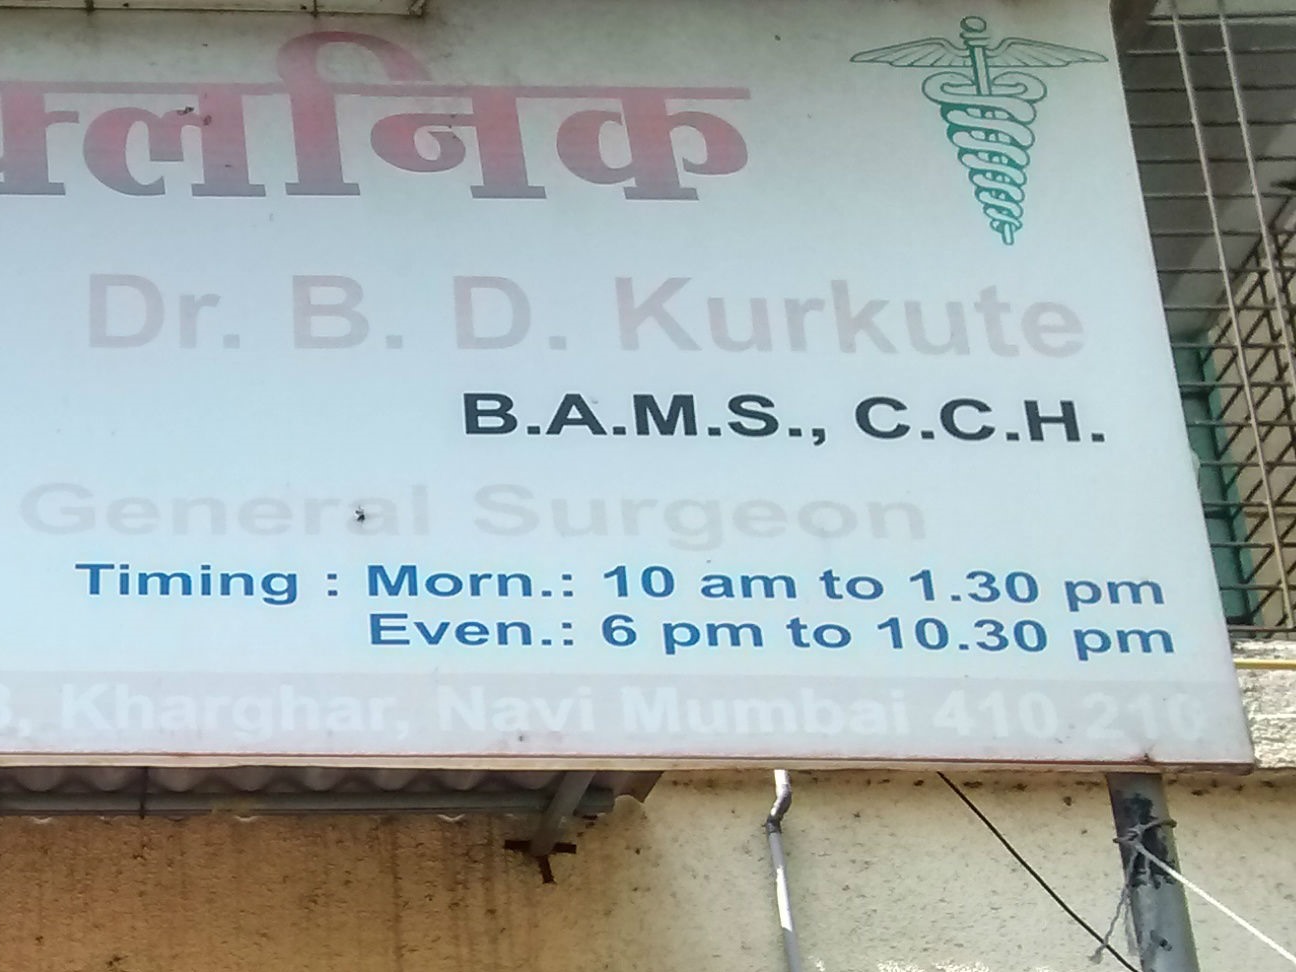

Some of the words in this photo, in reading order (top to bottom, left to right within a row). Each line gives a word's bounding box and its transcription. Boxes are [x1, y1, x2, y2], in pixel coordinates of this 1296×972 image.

[88, 272, 240, 350] Dr.
[291, 272, 404, 350] B.
[452, 275, 568, 351] D.
[613, 276, 1087, 359] Kurkute
[462, 392, 826, 446] B.A.M.S.,
[855, 396, 1106, 443] C.C.H.
[18, 480, 431, 537] General
[473, 483, 929, 552] Surgeon
[75, 563, 298, 605] Timing
[367, 564, 574, 598] Morn.:
[603, 565, 675, 598] 10
[700, 570, 797, 600] am
[819, 569, 884, 601] to
[909, 569, 1039, 603] 1.30
[1065, 578, 1165, 612] pm
[369, 612, 574, 646] Even.:
[601, 614, 638, 648] 6
[662, 621, 764, 655] pm
[786, 617, 852, 648] to
[877, 618, 1048, 653] 10.30
[1073, 626, 1175, 661] pm
[61, 683, 410, 742] Kharghar,
[437, 685, 596, 733] Navi
[621, 686, 911, 737] Mumbai
[933, 688, 1058, 740] 410
